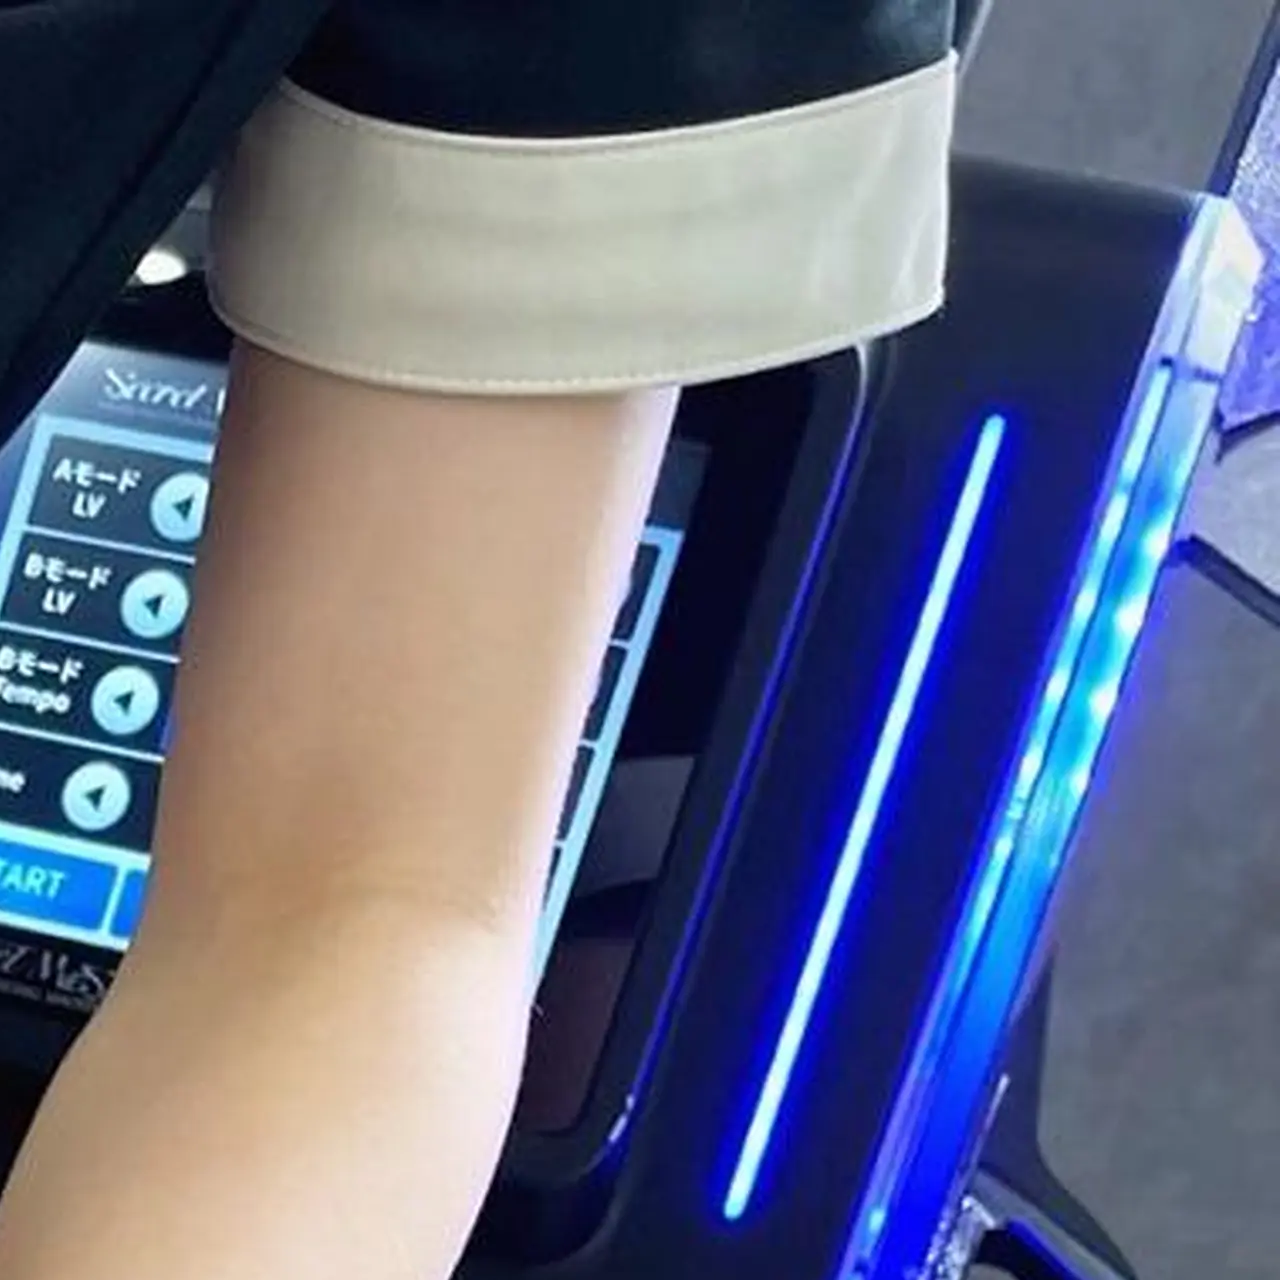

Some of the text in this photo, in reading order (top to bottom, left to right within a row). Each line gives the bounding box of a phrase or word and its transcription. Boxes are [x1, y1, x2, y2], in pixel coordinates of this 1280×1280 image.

[52, 458, 142, 494] Aモード
[72, 491, 107, 518] LV
[23, 552, 112, 590] Bモード
[42, 587, 77, 615] LV
